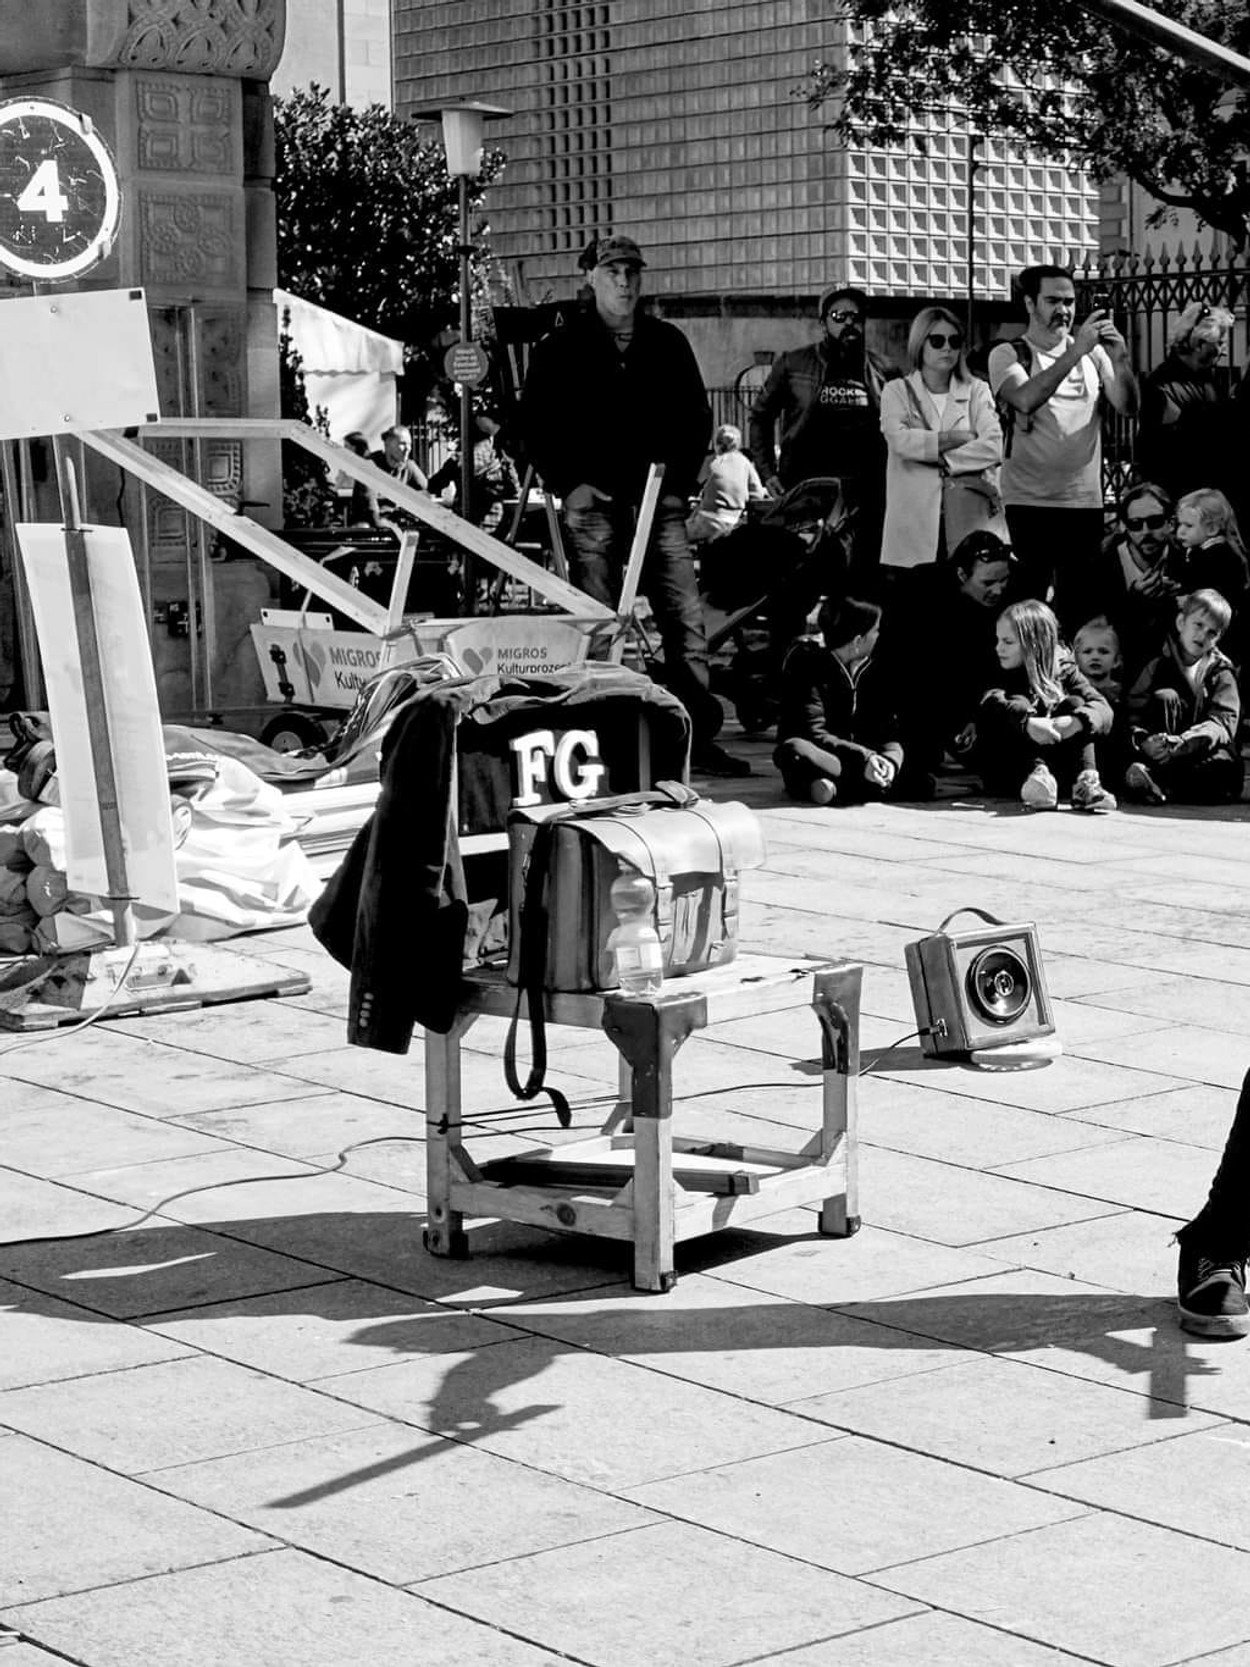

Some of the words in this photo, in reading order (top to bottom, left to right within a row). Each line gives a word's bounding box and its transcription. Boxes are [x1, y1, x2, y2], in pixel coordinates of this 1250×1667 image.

[16, 160, 69, 223] 4
[497, 646, 548, 659] MIGROS
[509, 728, 605, 806] FG
